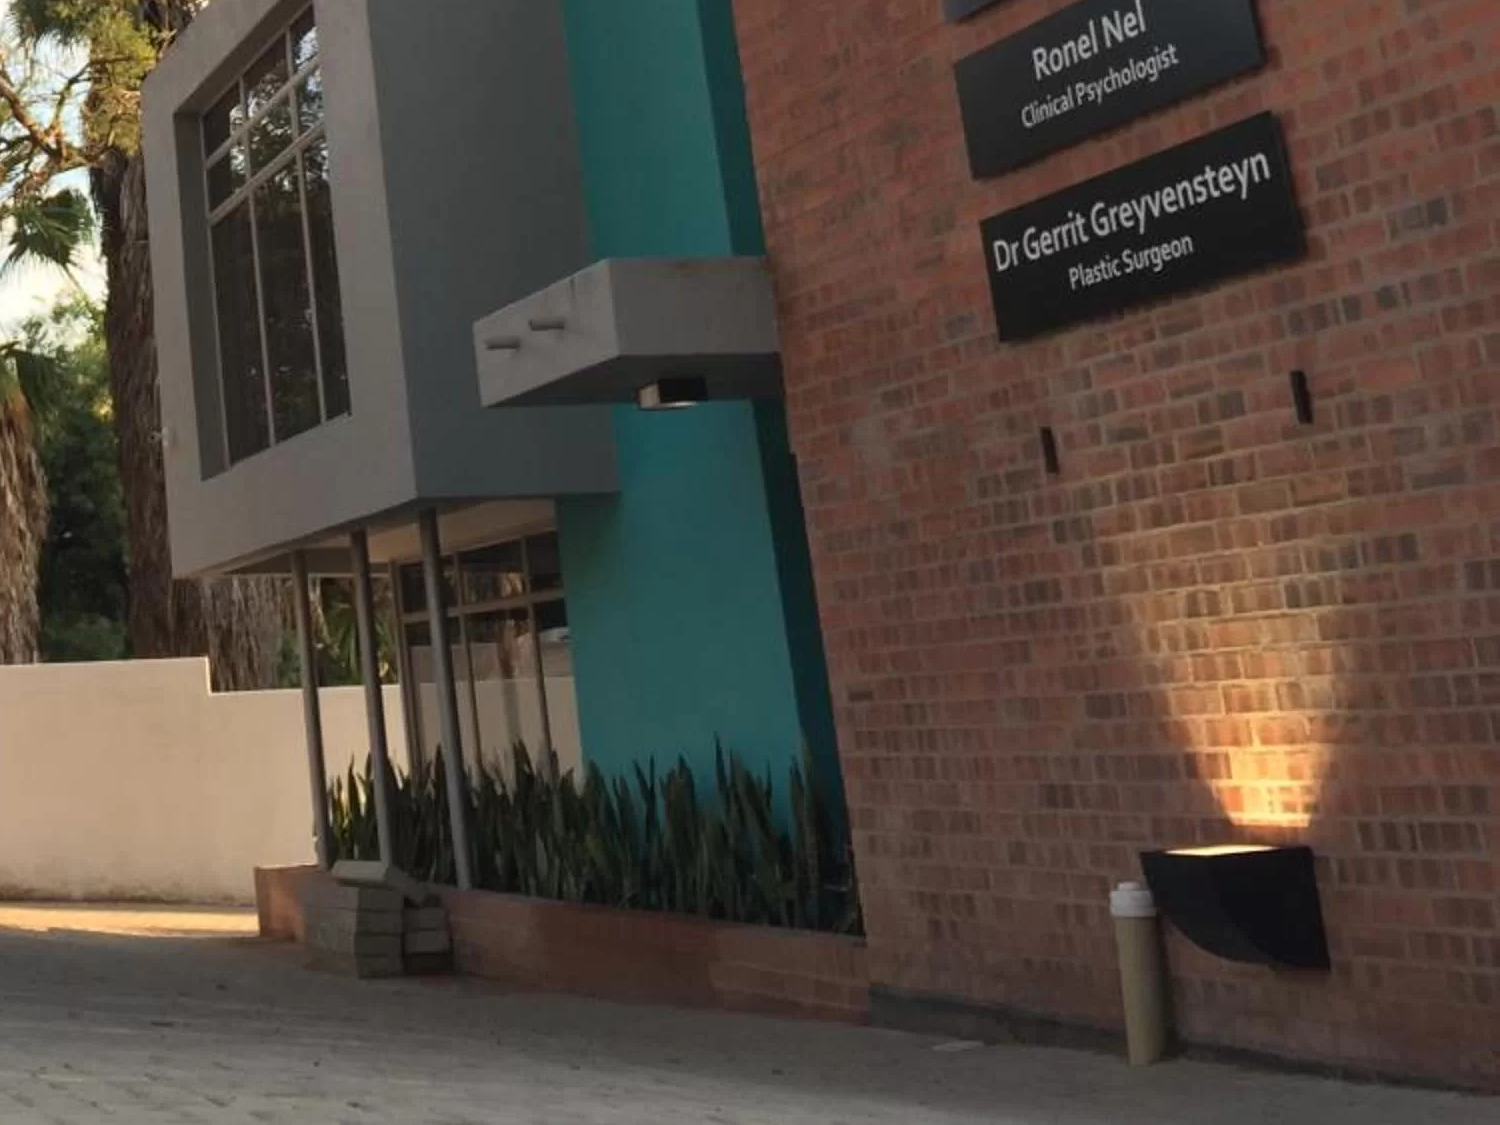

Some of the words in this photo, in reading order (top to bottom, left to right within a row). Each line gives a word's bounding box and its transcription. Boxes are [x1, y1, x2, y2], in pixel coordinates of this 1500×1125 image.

[1021, 85, 1074, 129] Clinical
[1075, 43, 1180, 106] Psychologist
[1032, 19, 1099, 80] Ronel
[993, 239, 1018, 272] Dr
[1022, 211, 1089, 261] Gerrit
[1090, 151, 1271, 237] Greyvensteyn
[1068, 252, 1122, 291] Plastic
[1122, 234, 1193, 272] Surgeon
